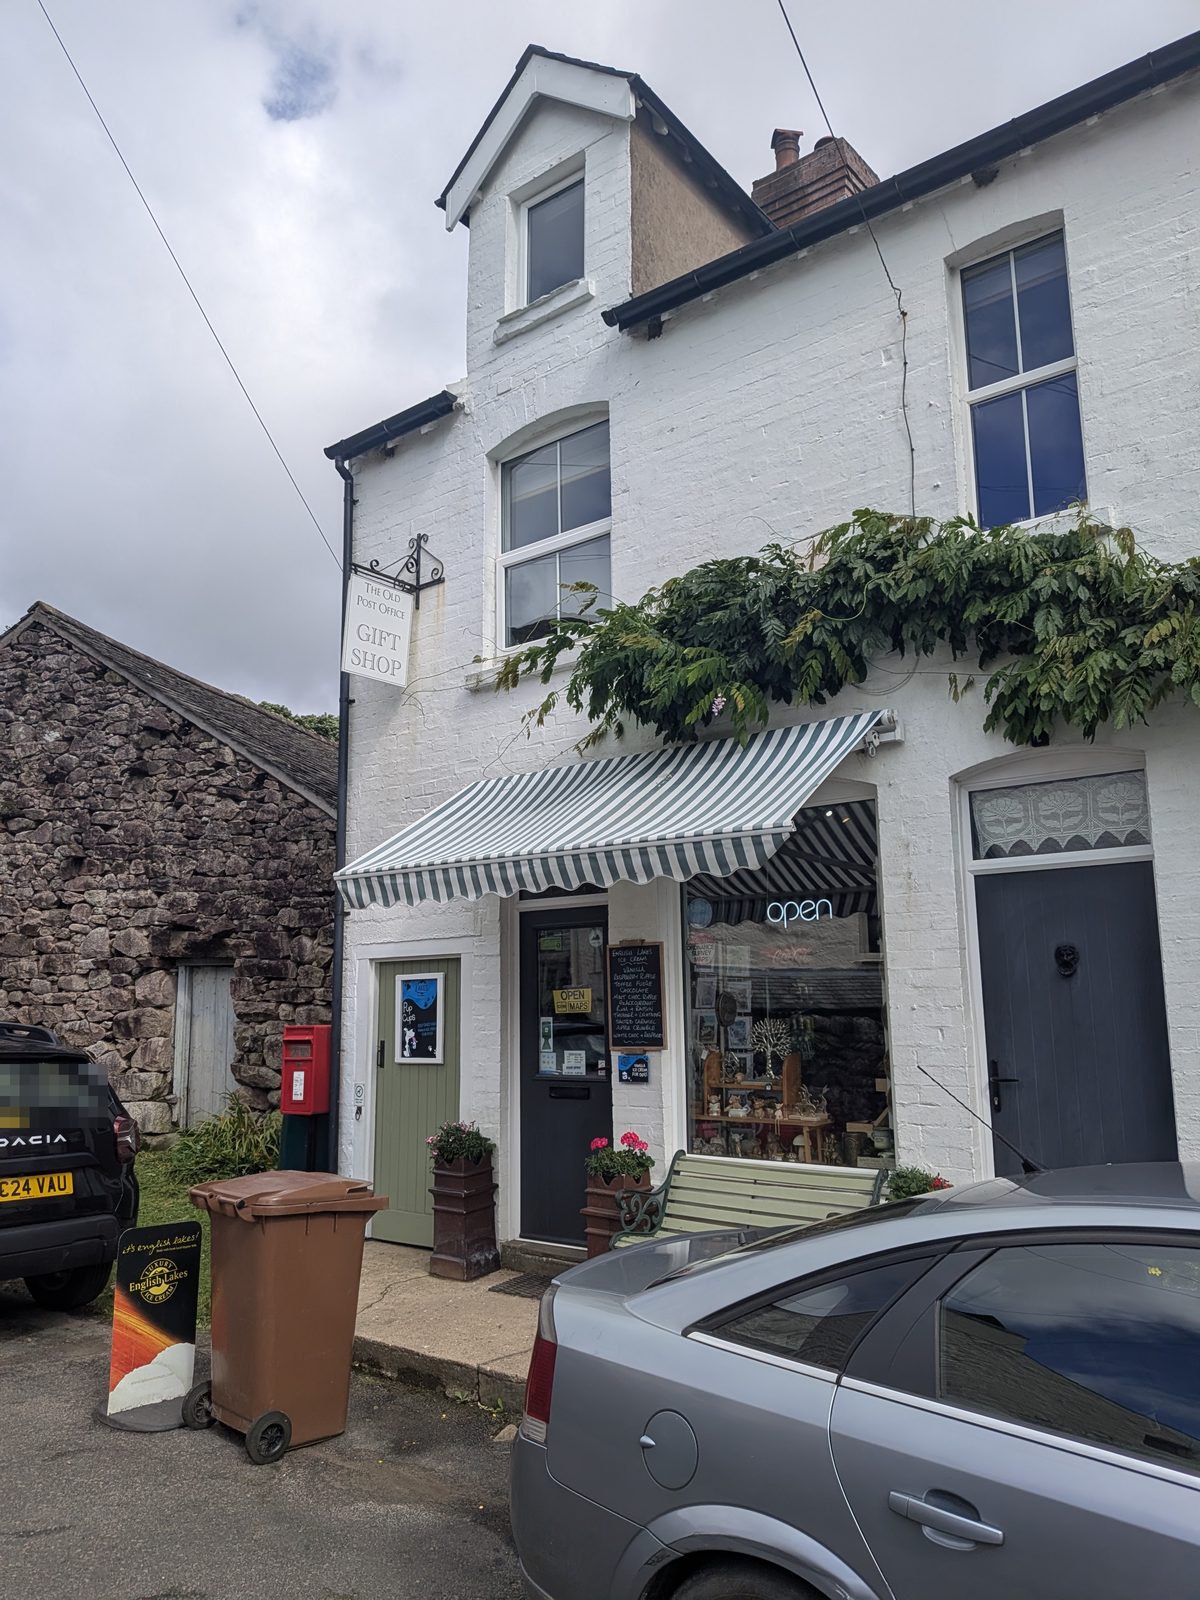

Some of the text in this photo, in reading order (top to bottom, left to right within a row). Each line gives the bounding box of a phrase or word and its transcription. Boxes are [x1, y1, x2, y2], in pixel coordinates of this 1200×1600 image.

[364, 582, 400, 603] THE OLD
[356, 594, 406, 620] POST OFFICE
[356, 623, 401, 651] GIFT
[350, 648, 402, 677] SHOP
[766, 898, 832, 928] open
[560, 990, 585, 1000] OPEN
[403, 1001, 413, 1015] Pup
[402, 1014, 416, 1024] Cups
[0, 1134, 67, 1147] DACIA
[37, 1175, 66, 1194] VAU
[122, 1244, 135, 1254] it's
[138, 1238, 170, 1255] english
[173, 1232, 200, 1245] lakes!
[145, 1261, 172, 1275] LUXURY
[129, 1270, 188, 1292] English Lakes
[145, 1285, 174, 1301] ICE CREAM
